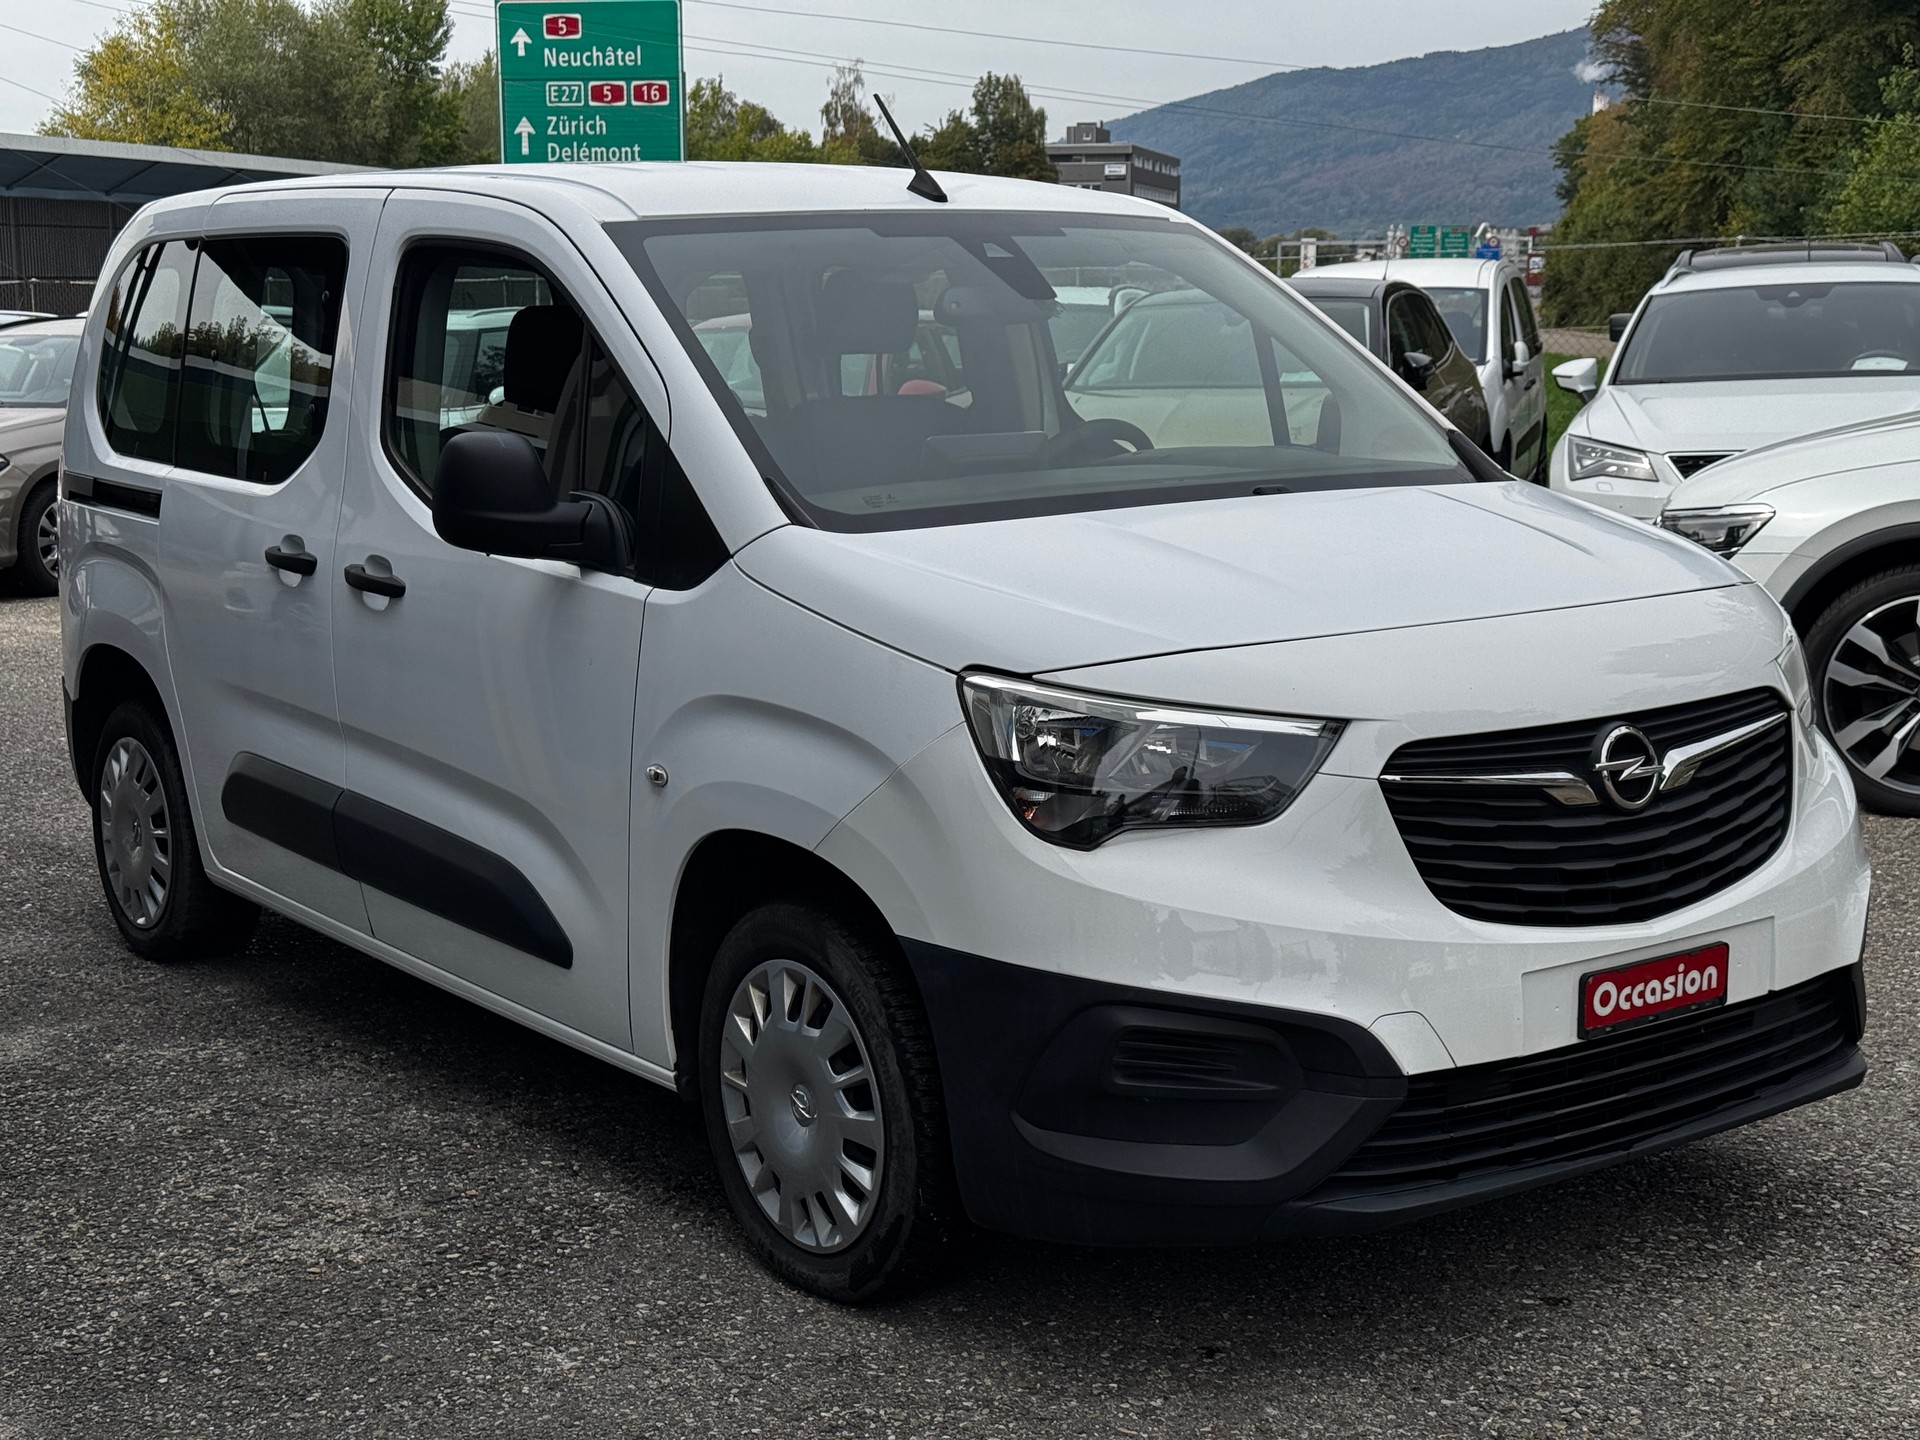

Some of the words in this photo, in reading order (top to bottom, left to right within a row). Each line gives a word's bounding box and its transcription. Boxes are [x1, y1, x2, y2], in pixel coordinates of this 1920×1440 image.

[558, 18, 567, 35] 5
[543, 45, 642, 68] Neuchâtel
[603, 86, 612, 101] 5
[641, 85, 660, 101] 16
[546, 115, 607, 135] Zürich
[547, 141, 641, 162] Delémont
[1593, 963, 1718, 1017] Occasion
